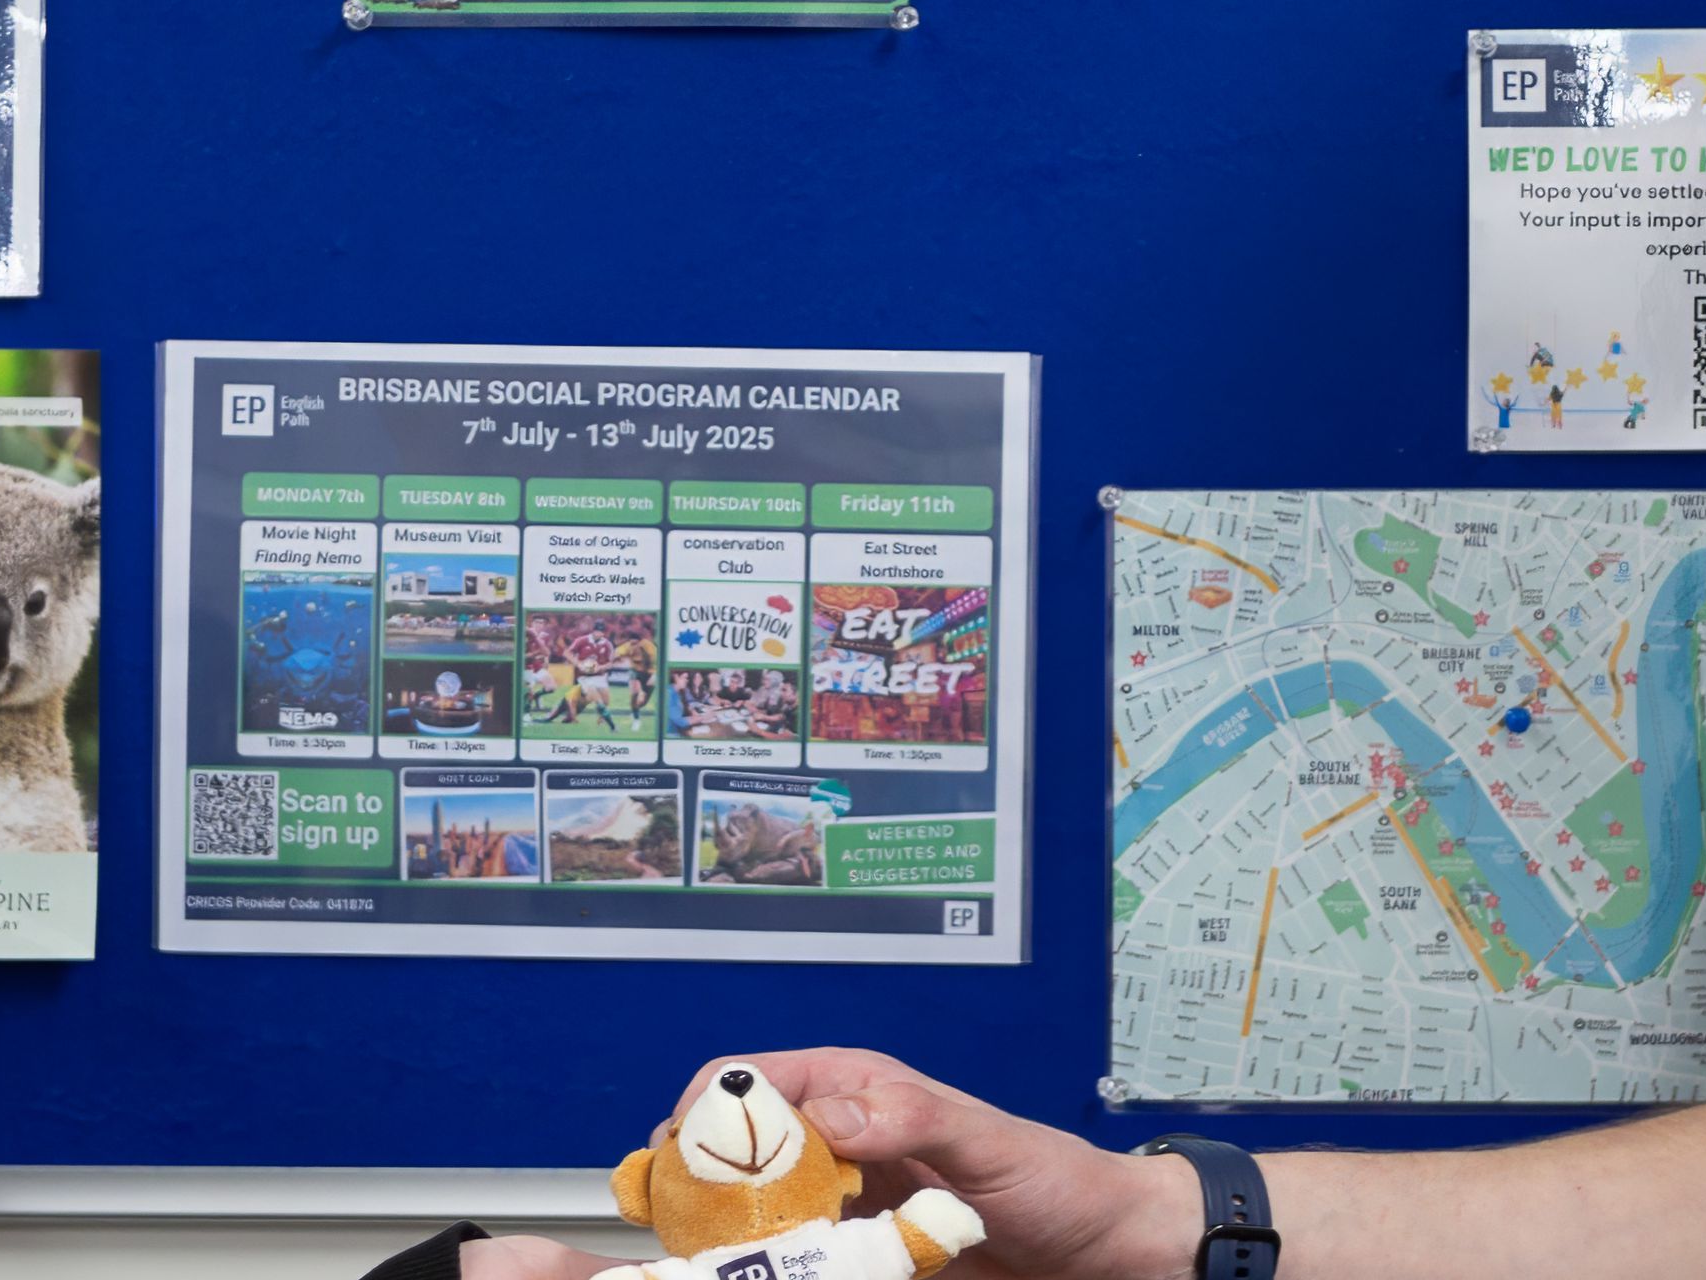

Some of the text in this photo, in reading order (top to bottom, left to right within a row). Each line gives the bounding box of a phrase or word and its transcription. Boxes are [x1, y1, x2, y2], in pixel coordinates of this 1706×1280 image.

[1502, 70, 1538, 101] EP
[1489, 147, 1554, 172] WE'D
[1568, 147, 1638, 171] LOVE
[1654, 148, 1686, 172] TO
[1521, 183, 1571, 203] Hope
[1577, 183, 1642, 203] you've
[1520, 212, 1564, 227] Your
[1570, 214, 1621, 231] input
[1626, 215, 1642, 227] is
[338, 377, 900, 412] BRISBANE SOCIAL PROGRAM CALENDAR
[232, 395, 266, 425] EP
[502, 420, 560, 452] July
[642, 423, 700, 455] July
[705, 425, 774, 450] 2025
[257, 487, 365, 503] MONDAY 7th
[400, 490, 506, 506] TUESDAY 8th
[534, 495, 626, 511] WEDNESDAY
[673, 495, 761, 511] THURSDAY
[841, 494, 955, 517] Friday 11th
[261, 525, 356, 544] Movie Night
[394, 528, 502, 544] Museum Visit
[1454, 522, 1499, 536] SPRING
[683, 538, 785, 551] conservation
[864, 541, 937, 556] Eat Street
[1463, 535, 1488, 548] HILL
[254, 549, 362, 567] Finding Nemo
[717, 560, 754, 575] Club
[860, 565, 944, 579] Northshore
[678, 605, 794, 640] CONVERSATION
[840, 607, 931, 646] EAT
[1132, 624, 1180, 636] MILTON
[706, 622, 757, 652] CLUB
[1421, 647, 1482, 661] BRISBANE
[1438, 659, 1465, 673] CITY
[813, 661, 976, 696] STREET
[1309, 760, 1351, 772] SOUTH
[1298, 772, 1362, 786] BRISBANE
[280, 787, 383, 814] Scan to
[281, 819, 379, 850] sign up
[866, 824, 956, 842] WEEKEND
[841, 843, 982, 862] ACTIVITES AND
[848, 863, 976, 884] SUGGESTIONS
[950, 908, 974, 928] EP
